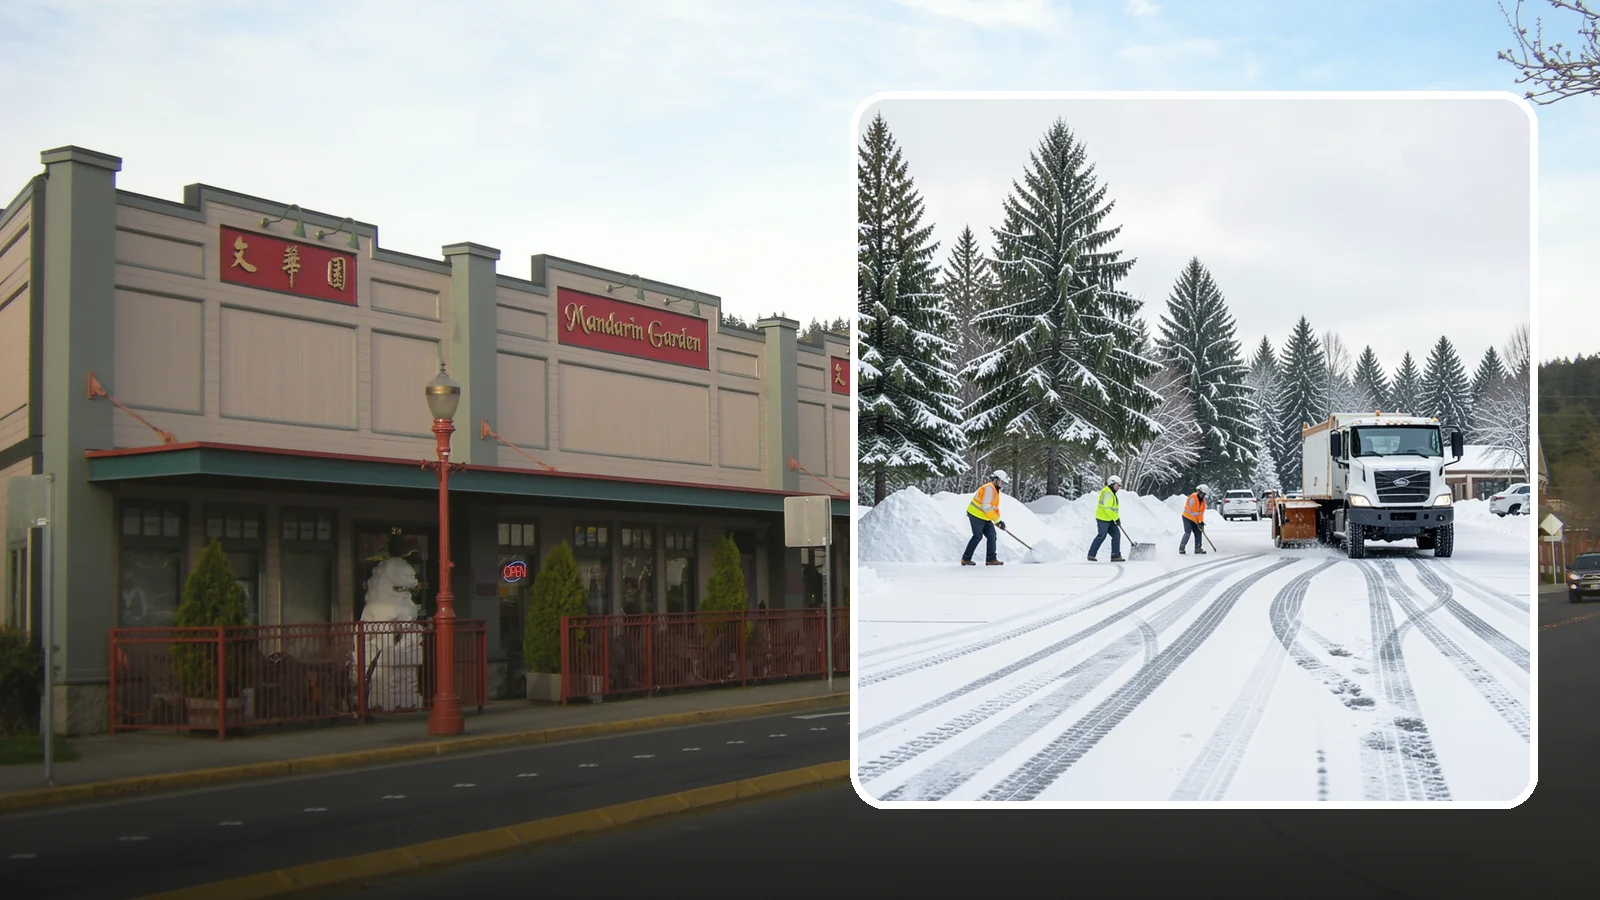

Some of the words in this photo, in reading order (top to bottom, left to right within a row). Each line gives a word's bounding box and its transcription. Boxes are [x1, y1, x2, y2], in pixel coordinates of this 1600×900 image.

[230, 235, 346, 291] 文華園
[564, 302, 644, 341] Mandarin
[647, 320, 701, 352] Garden
[503, 565, 527, 578] OPEN
